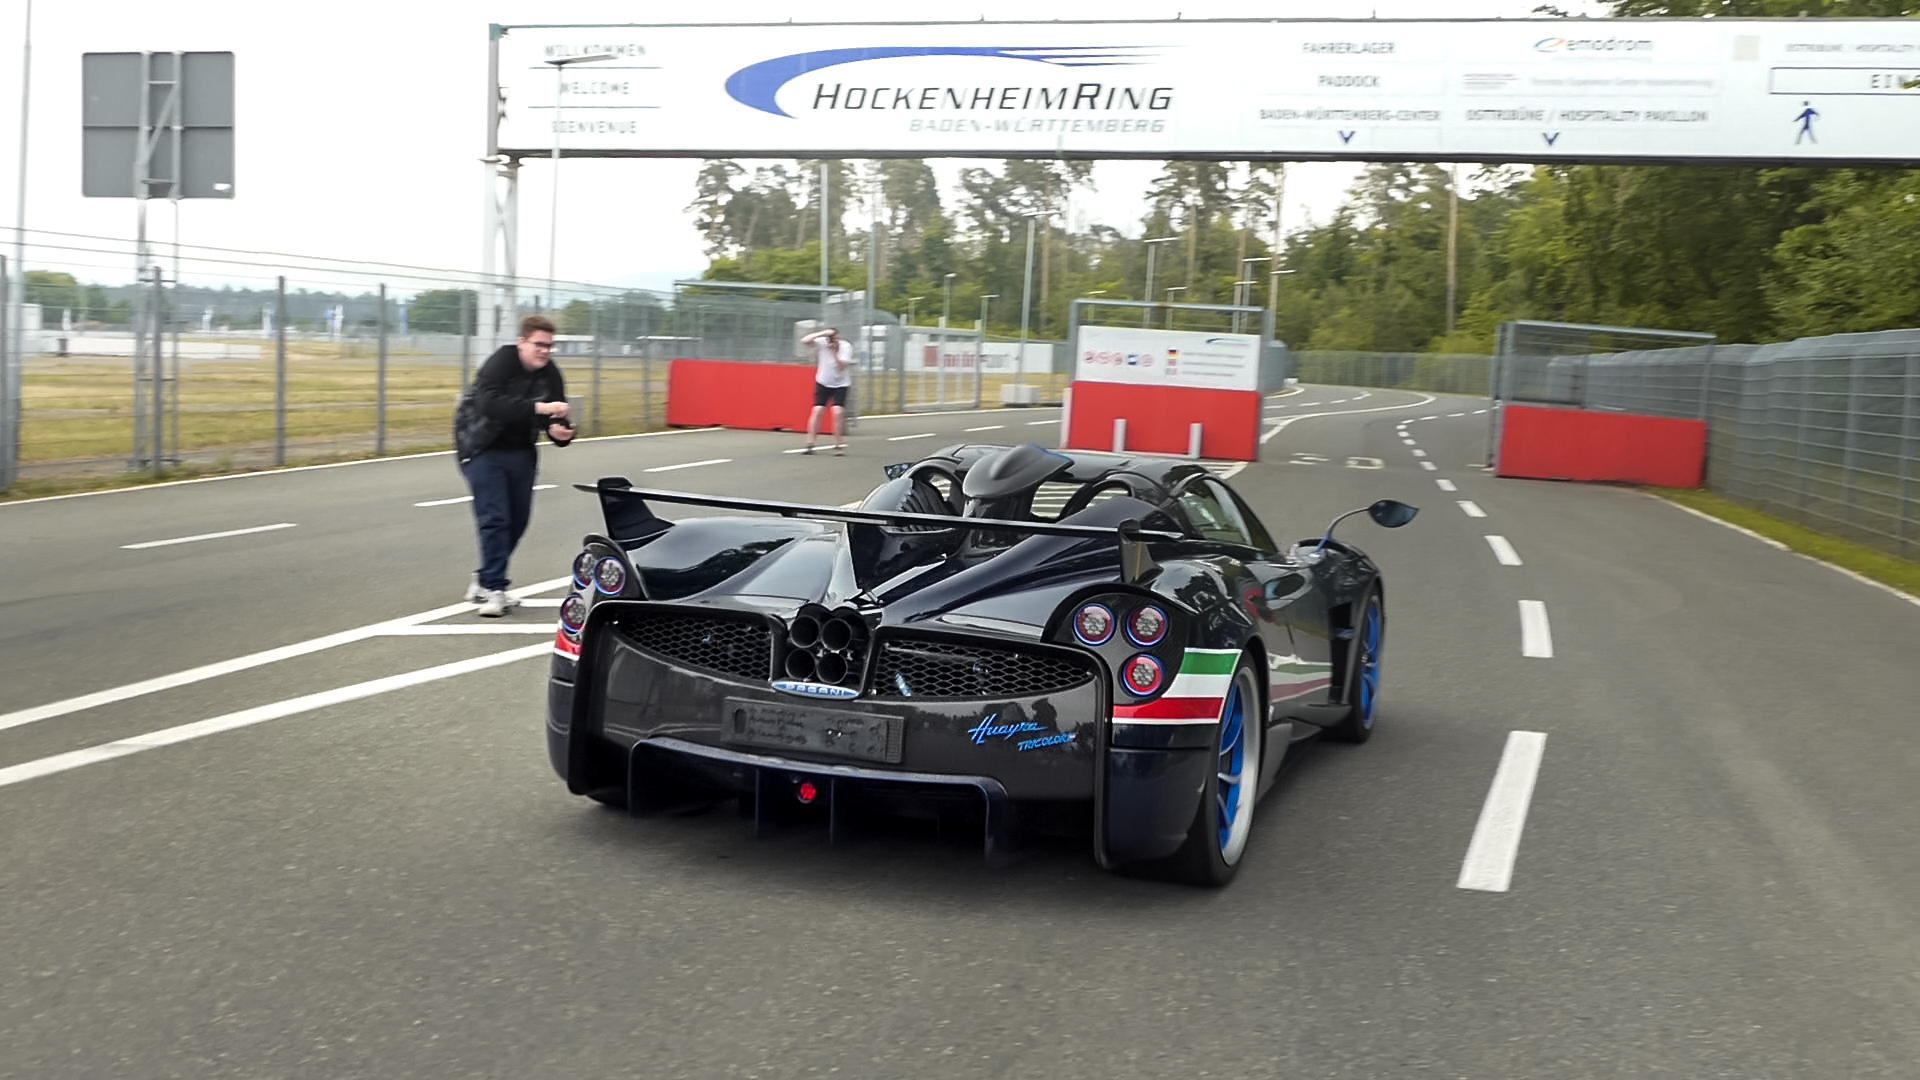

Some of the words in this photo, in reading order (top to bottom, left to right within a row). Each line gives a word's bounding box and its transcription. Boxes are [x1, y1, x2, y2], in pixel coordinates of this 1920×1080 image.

[1302, 42, 1396, 54] FAHRERLAGER
[1567, 37, 1653, 51] emodrom
[560, 81, 631, 95] WELCOME
[1317, 75, 1380, 87] PADDOCK
[785, 682, 846, 697] PAGANI
[967, 713, 1048, 745] Huayra
